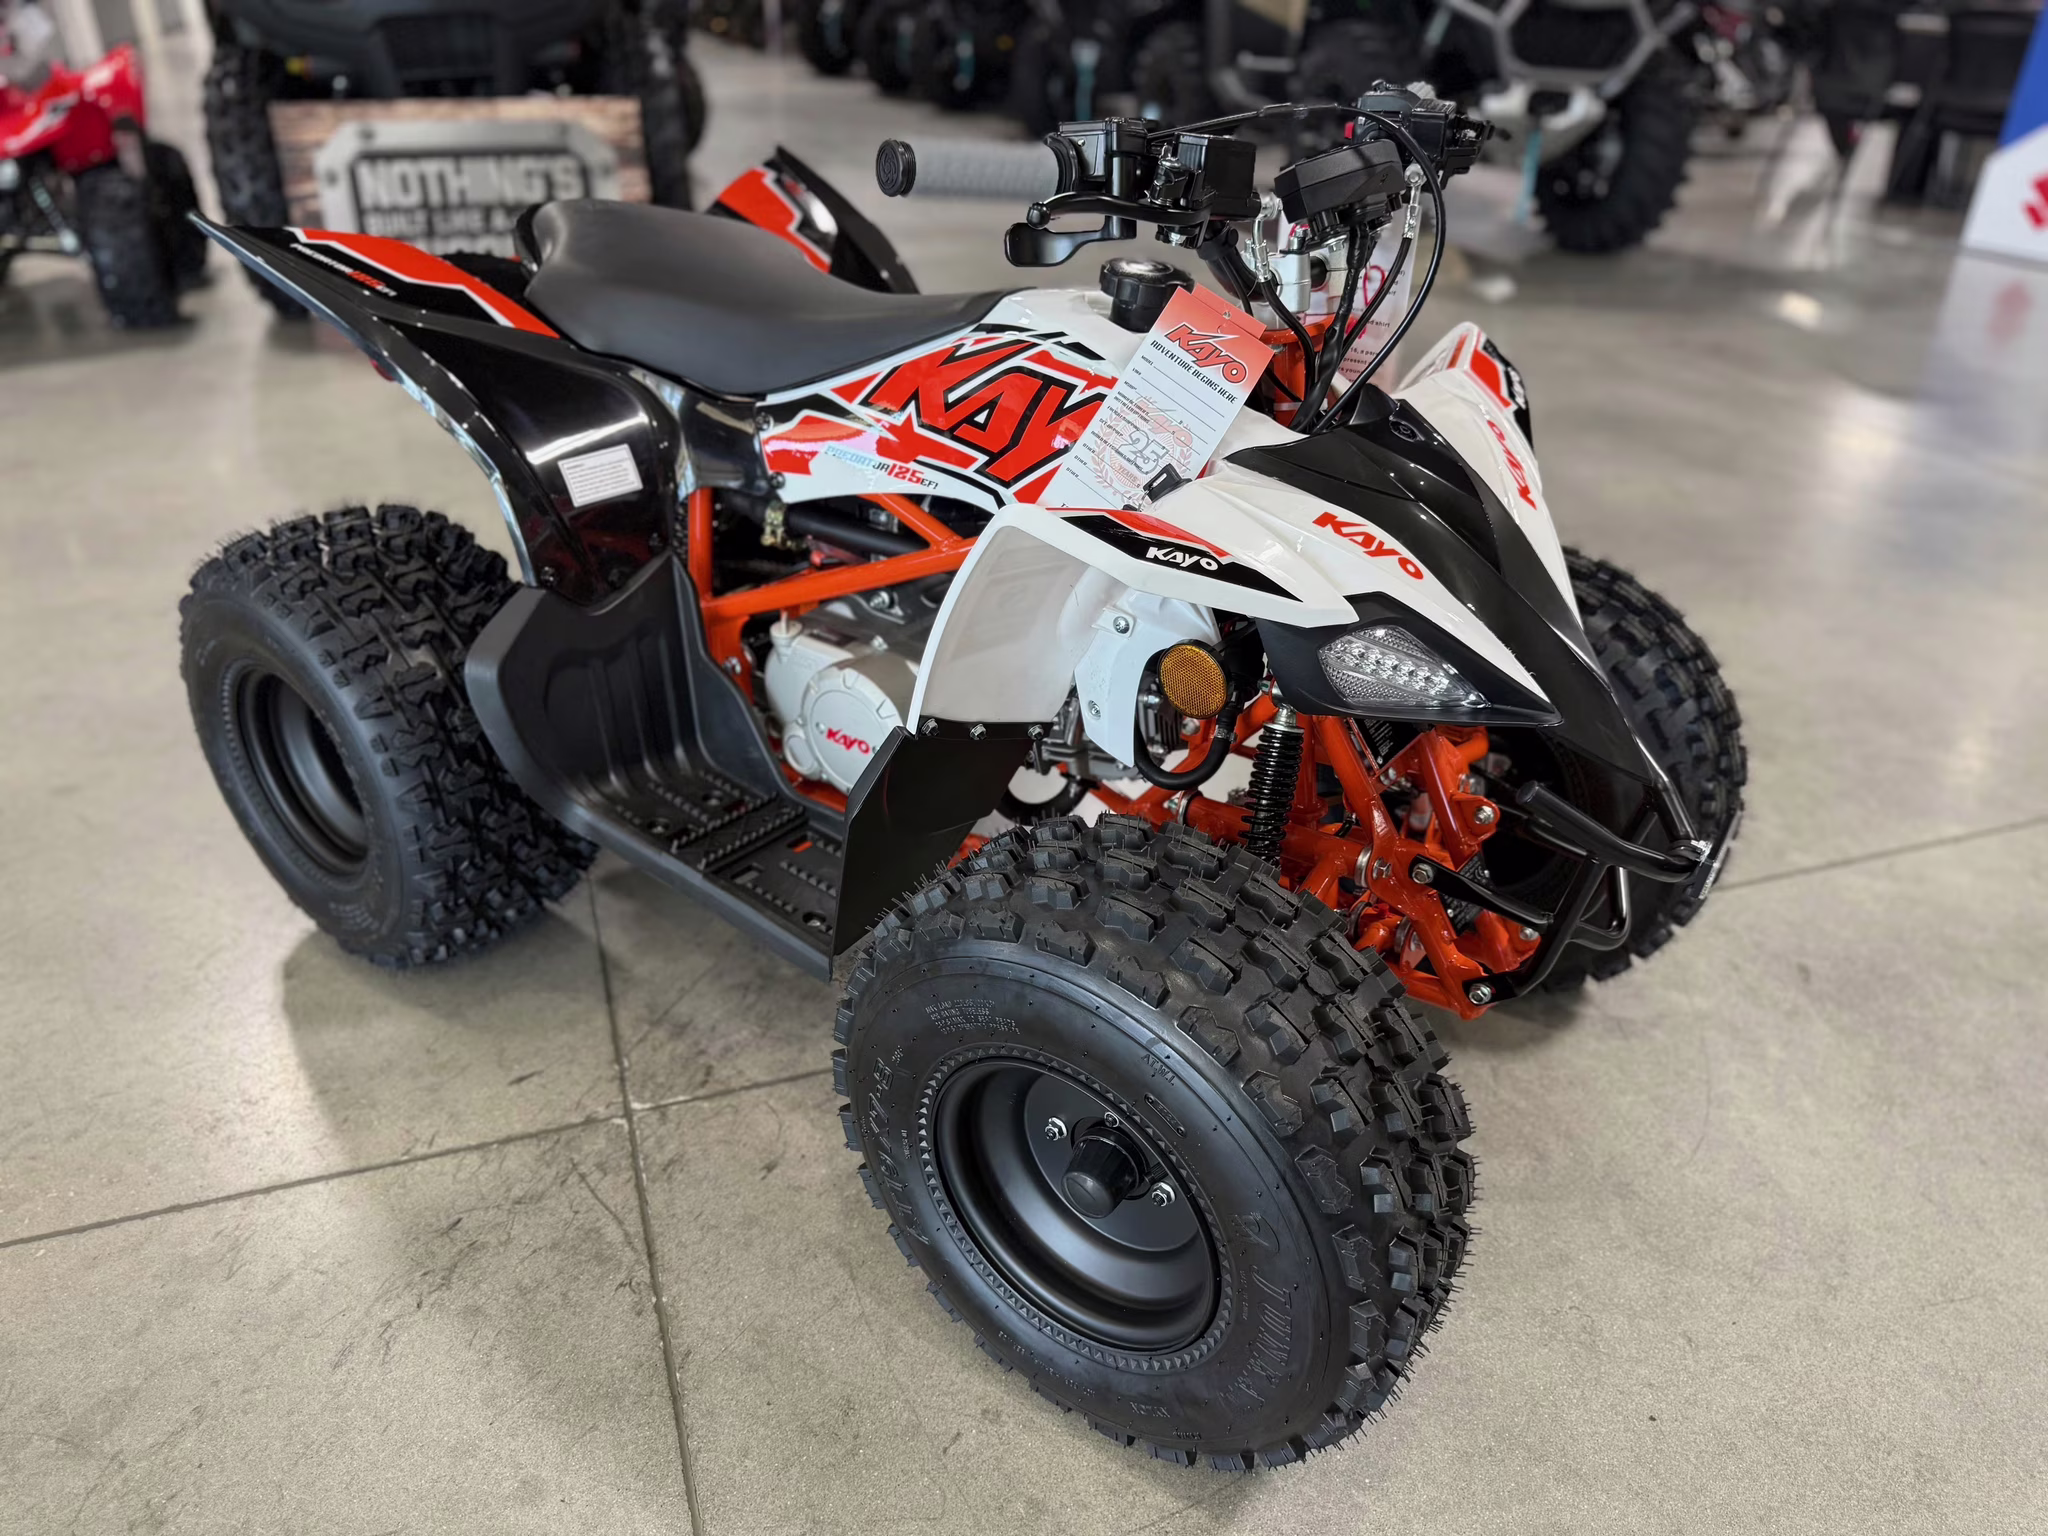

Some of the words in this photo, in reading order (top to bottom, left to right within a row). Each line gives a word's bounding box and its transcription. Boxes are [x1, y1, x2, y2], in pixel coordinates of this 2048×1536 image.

[361, 157, 581, 208] NOTHNG'S
[1149, 339, 1194, 374] ADVENTURE
[1191, 368, 1220, 392] BEGINS
[1217, 387, 1238, 405] HERE
[1164, 323, 1247, 384] KAYO
[858, 340, 1106, 484] KAY
[1115, 429, 1170, 476] 25
[1487, 420, 1537, 510] KAYO
[1146, 546, 1219, 571] KAYO
[1312, 511, 1424, 580] KAYO
[826, 727, 871, 755] KAYO
